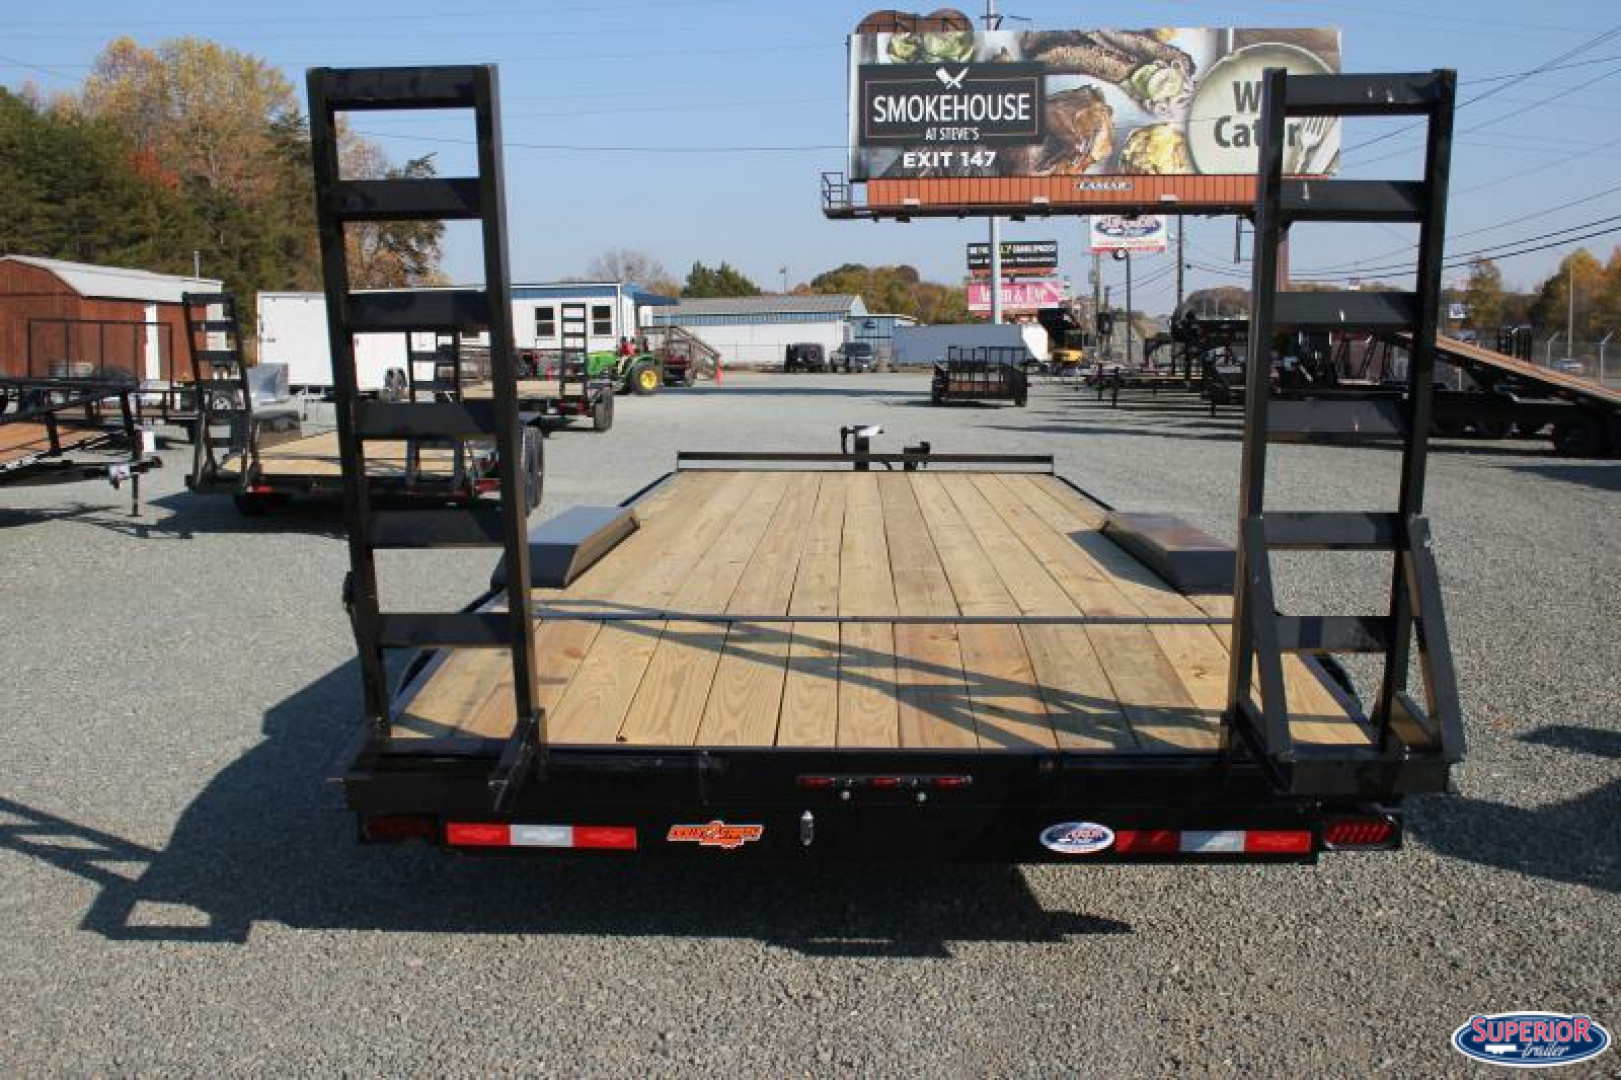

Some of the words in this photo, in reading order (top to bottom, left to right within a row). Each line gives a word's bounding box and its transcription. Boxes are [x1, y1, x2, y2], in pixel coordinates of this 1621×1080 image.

[873, 94, 1030, 123] SMOKEHOUSE
[1232, 81, 1263, 112] W
[925, 128, 937, 141] AT
[939, 127, 980, 141] STEVE'S
[1214, 115, 1301, 147] Catr
[903, 152, 953, 168] EXIT
[960, 151, 996, 167] 147
